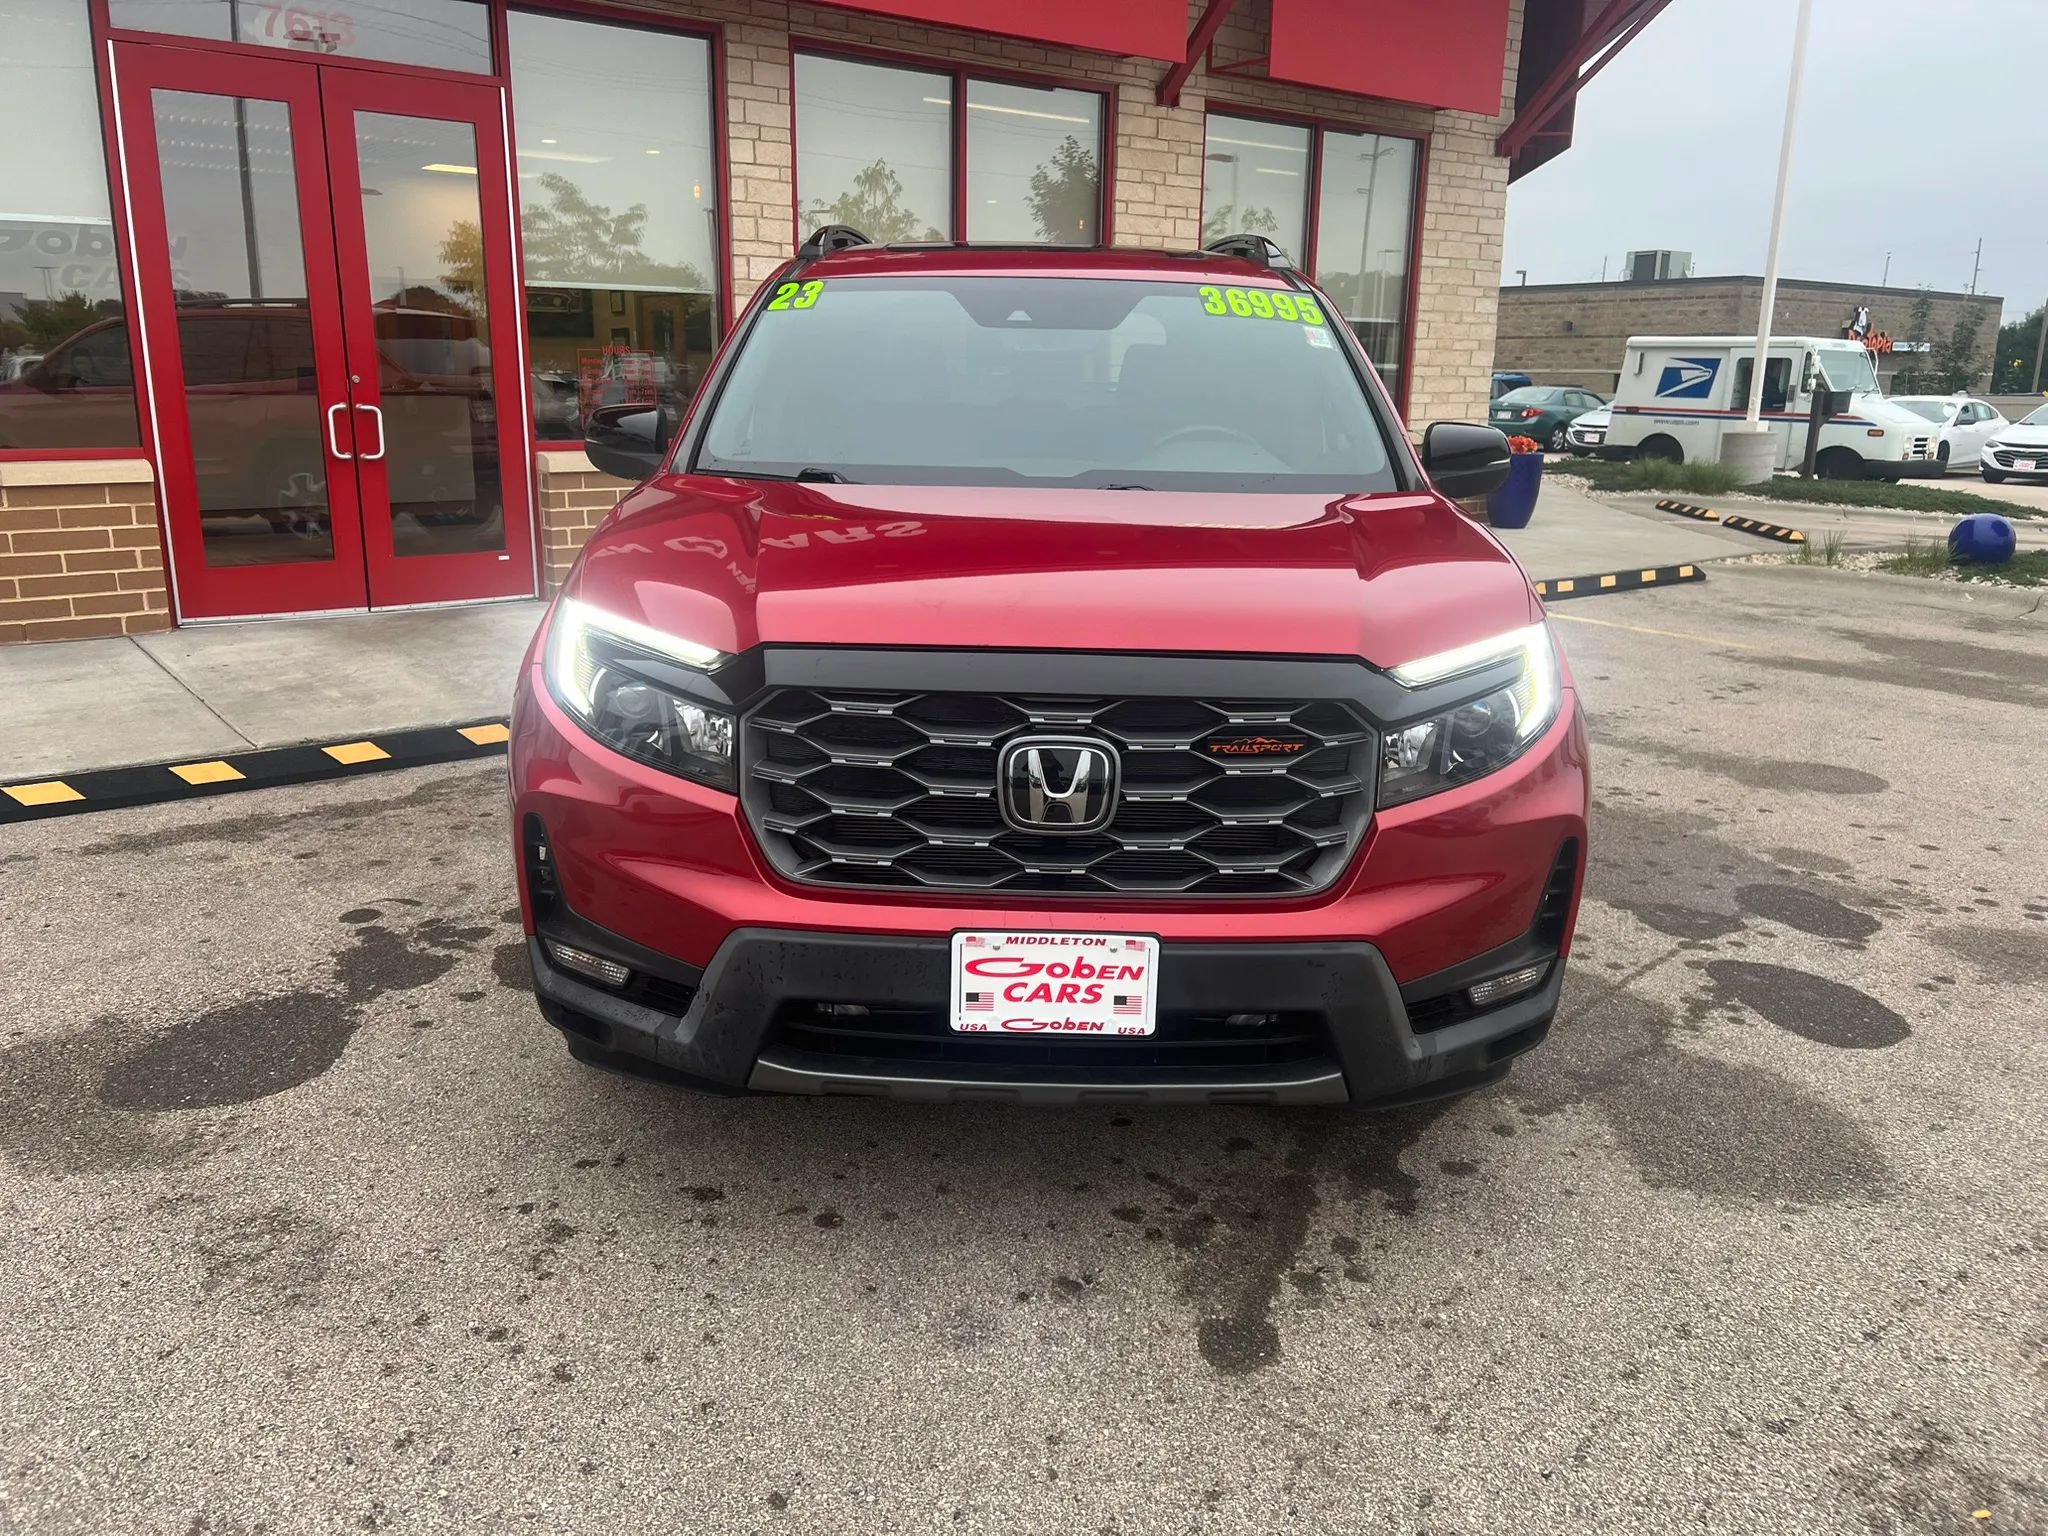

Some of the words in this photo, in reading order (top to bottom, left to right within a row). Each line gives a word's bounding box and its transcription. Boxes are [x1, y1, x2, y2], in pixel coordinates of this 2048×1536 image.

[767, 281, 825, 311] 23
[1199, 286, 1324, 326] 36995
[1210, 744, 1304, 753] TRAILSPORT
[1005, 936, 1106, 947] MIDDLETON
[1003, 982, 1104, 1004] CARS
[960, 1023, 988, 1032] USA
[1117, 1026, 1146, 1036] USA
